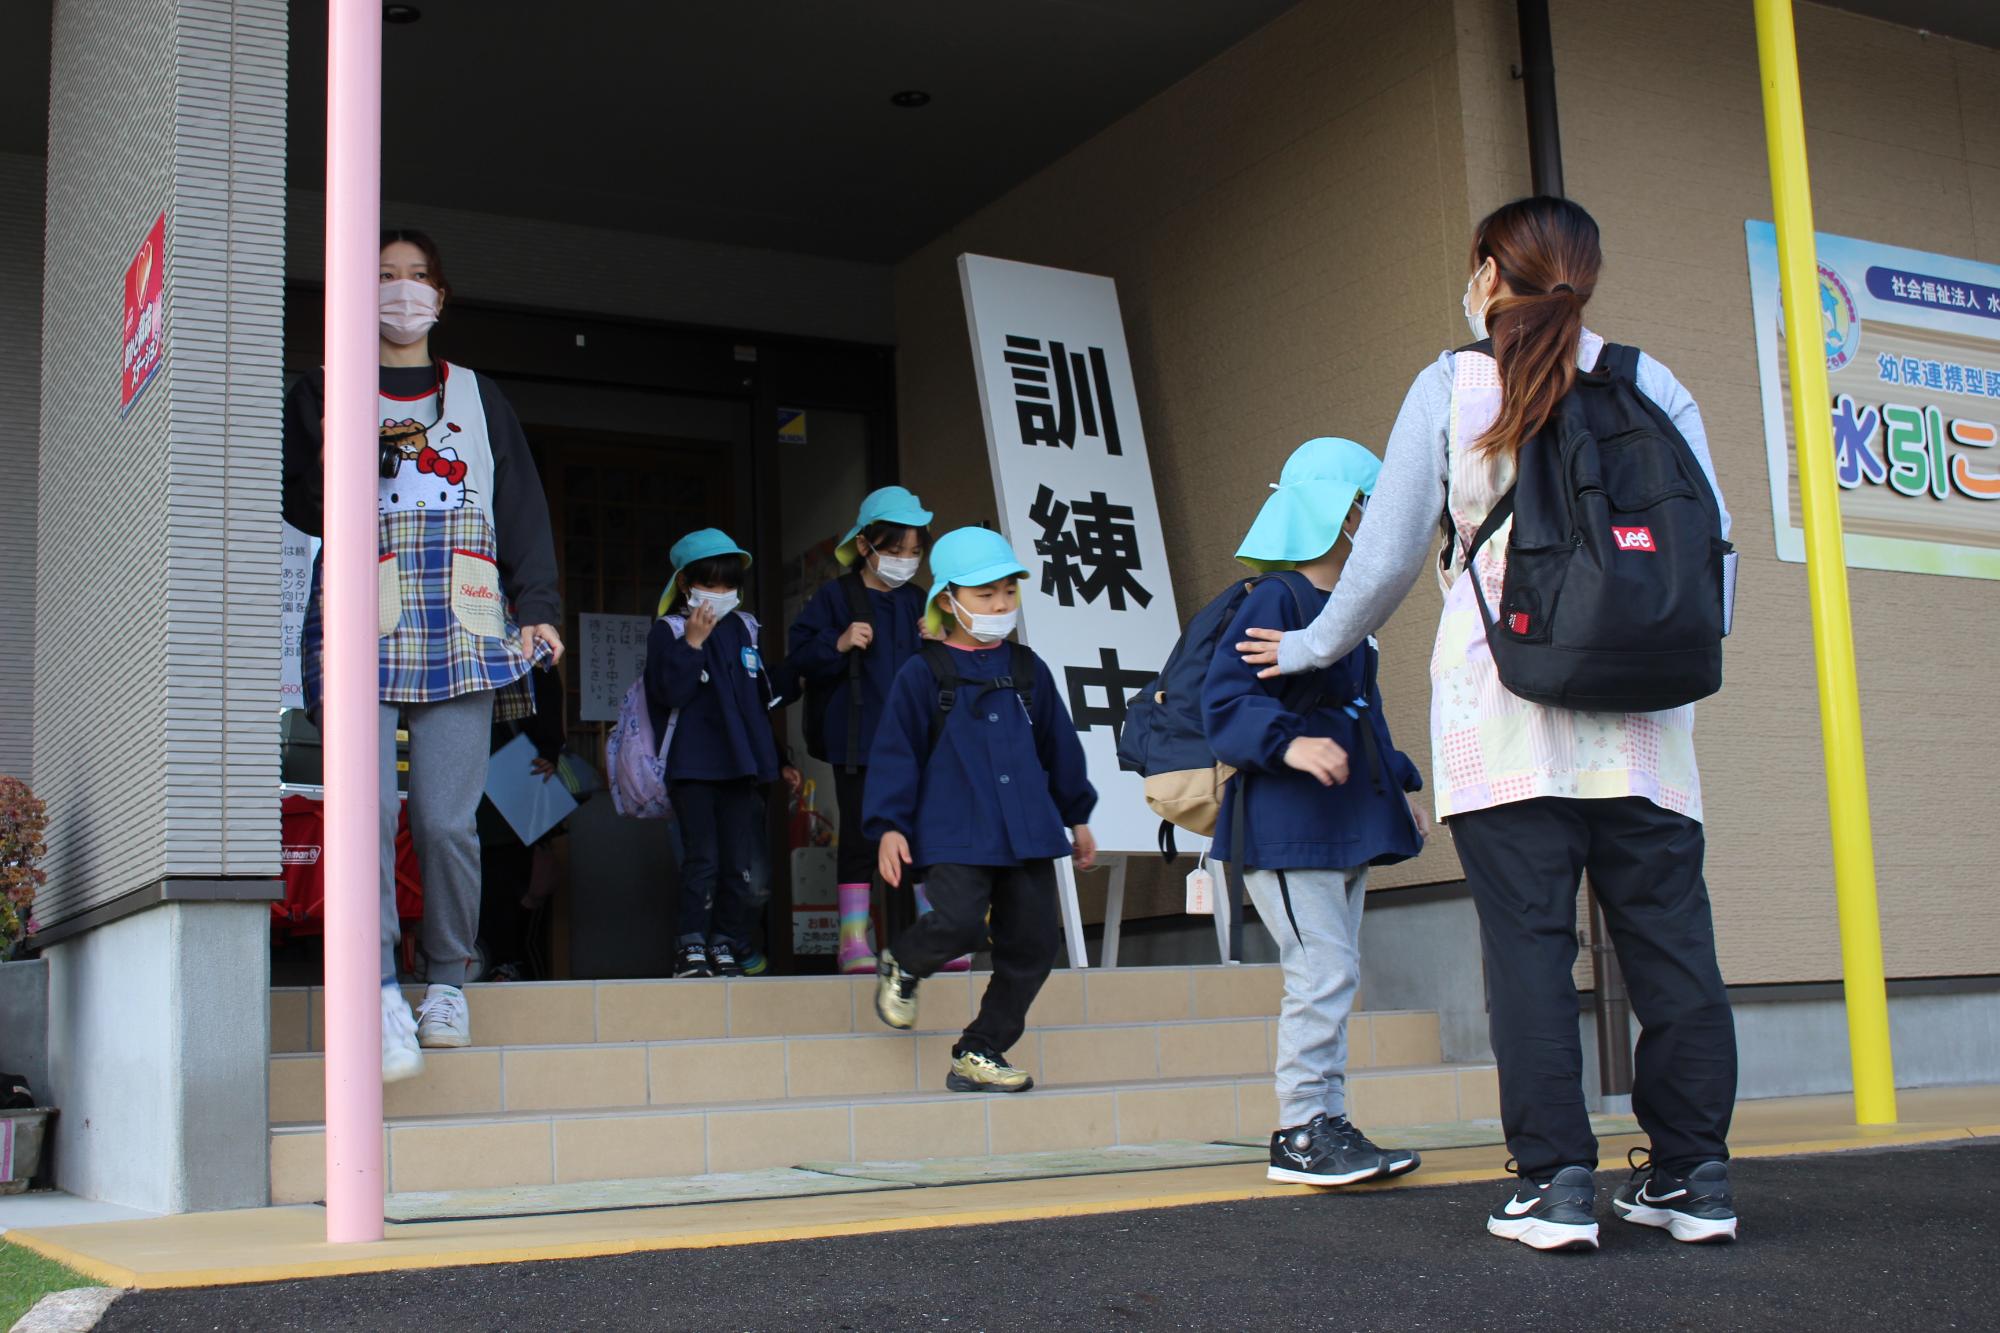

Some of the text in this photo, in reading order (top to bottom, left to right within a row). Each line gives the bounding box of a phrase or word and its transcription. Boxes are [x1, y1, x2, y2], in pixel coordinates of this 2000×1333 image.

[1892, 275, 1980, 310] 社会福祉法人
[131, 331, 160, 391] ステーション
[1003, 334, 1160, 757] 訓練中
[1613, 530, 1651, 547] Lee
[461, 584, 493, 599] Hello
